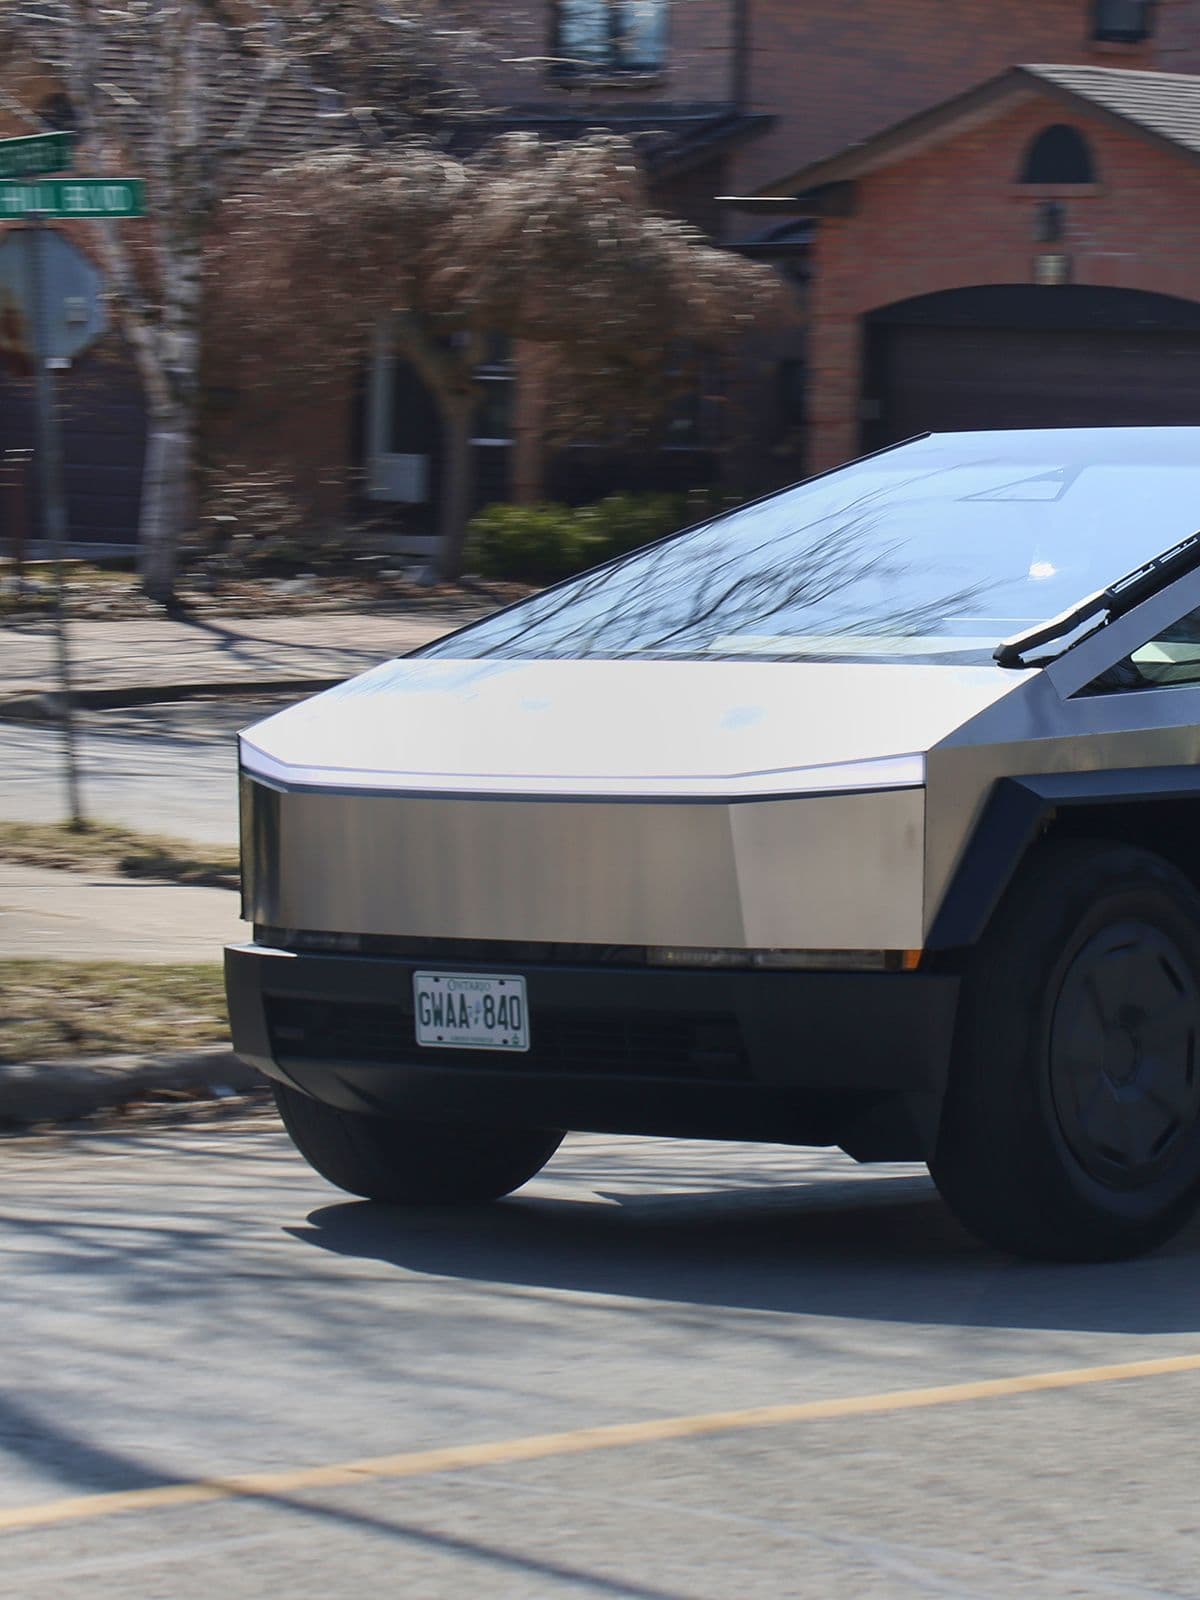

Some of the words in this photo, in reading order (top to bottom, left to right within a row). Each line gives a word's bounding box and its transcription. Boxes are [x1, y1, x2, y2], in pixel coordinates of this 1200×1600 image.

[62, 185, 132, 211] BLVD
[419, 991, 470, 1029] GWAA
[483, 994, 521, 1031] 840
